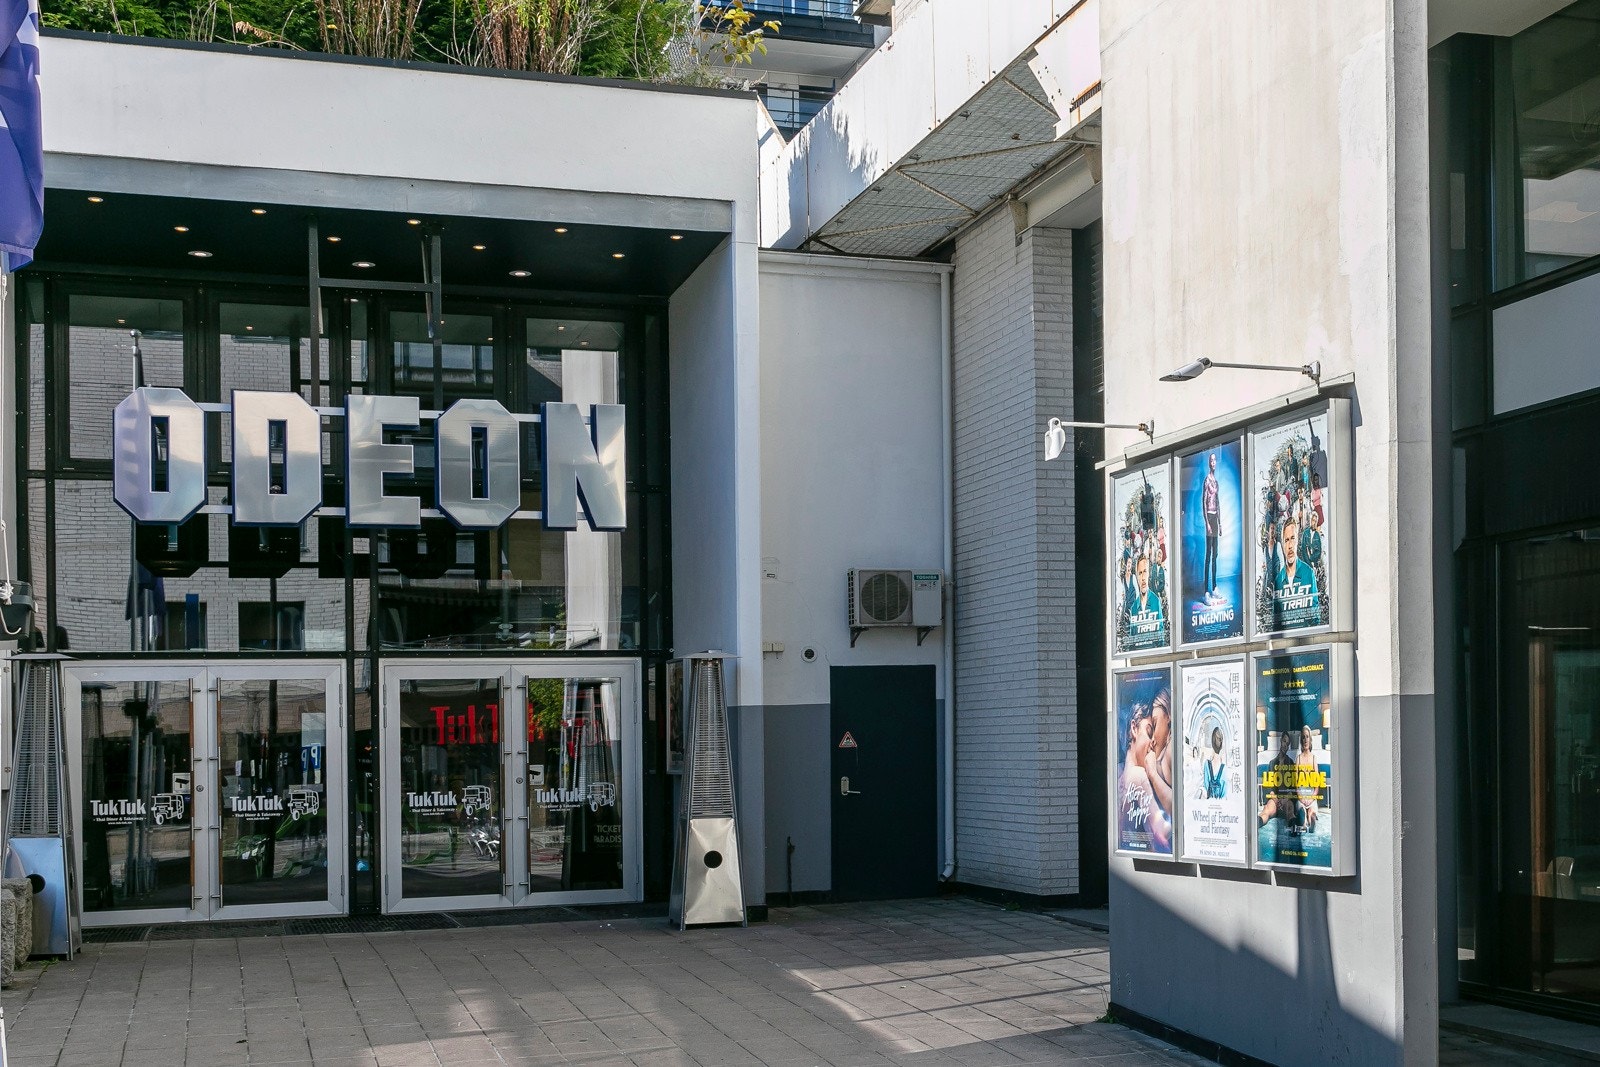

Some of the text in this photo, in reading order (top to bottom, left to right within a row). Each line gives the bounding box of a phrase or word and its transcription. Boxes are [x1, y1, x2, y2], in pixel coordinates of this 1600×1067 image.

[113, 386, 627, 532] ODEON
[1274, 584, 1312, 598] BULLET
[1282, 597, 1314, 610] TRAIN
[1130, 611, 1158, 623] BULLET
[1192, 609, 1234, 626] SI INGENTING
[1137, 622, 1160, 634] TRAIN
[430, 703, 544, 746] TukTk
[1262, 772, 1326, 788] LEO GRANDE
[230, 795, 283, 811] TukTuk
[406, 791, 457, 807] TukTuk
[534, 788, 582, 803] TukTuk
[90, 799, 146, 816] TukTuk
[1192, 810, 1239, 823] Wheel of Fortune
[1200, 823, 1230, 837] and Fantasy
